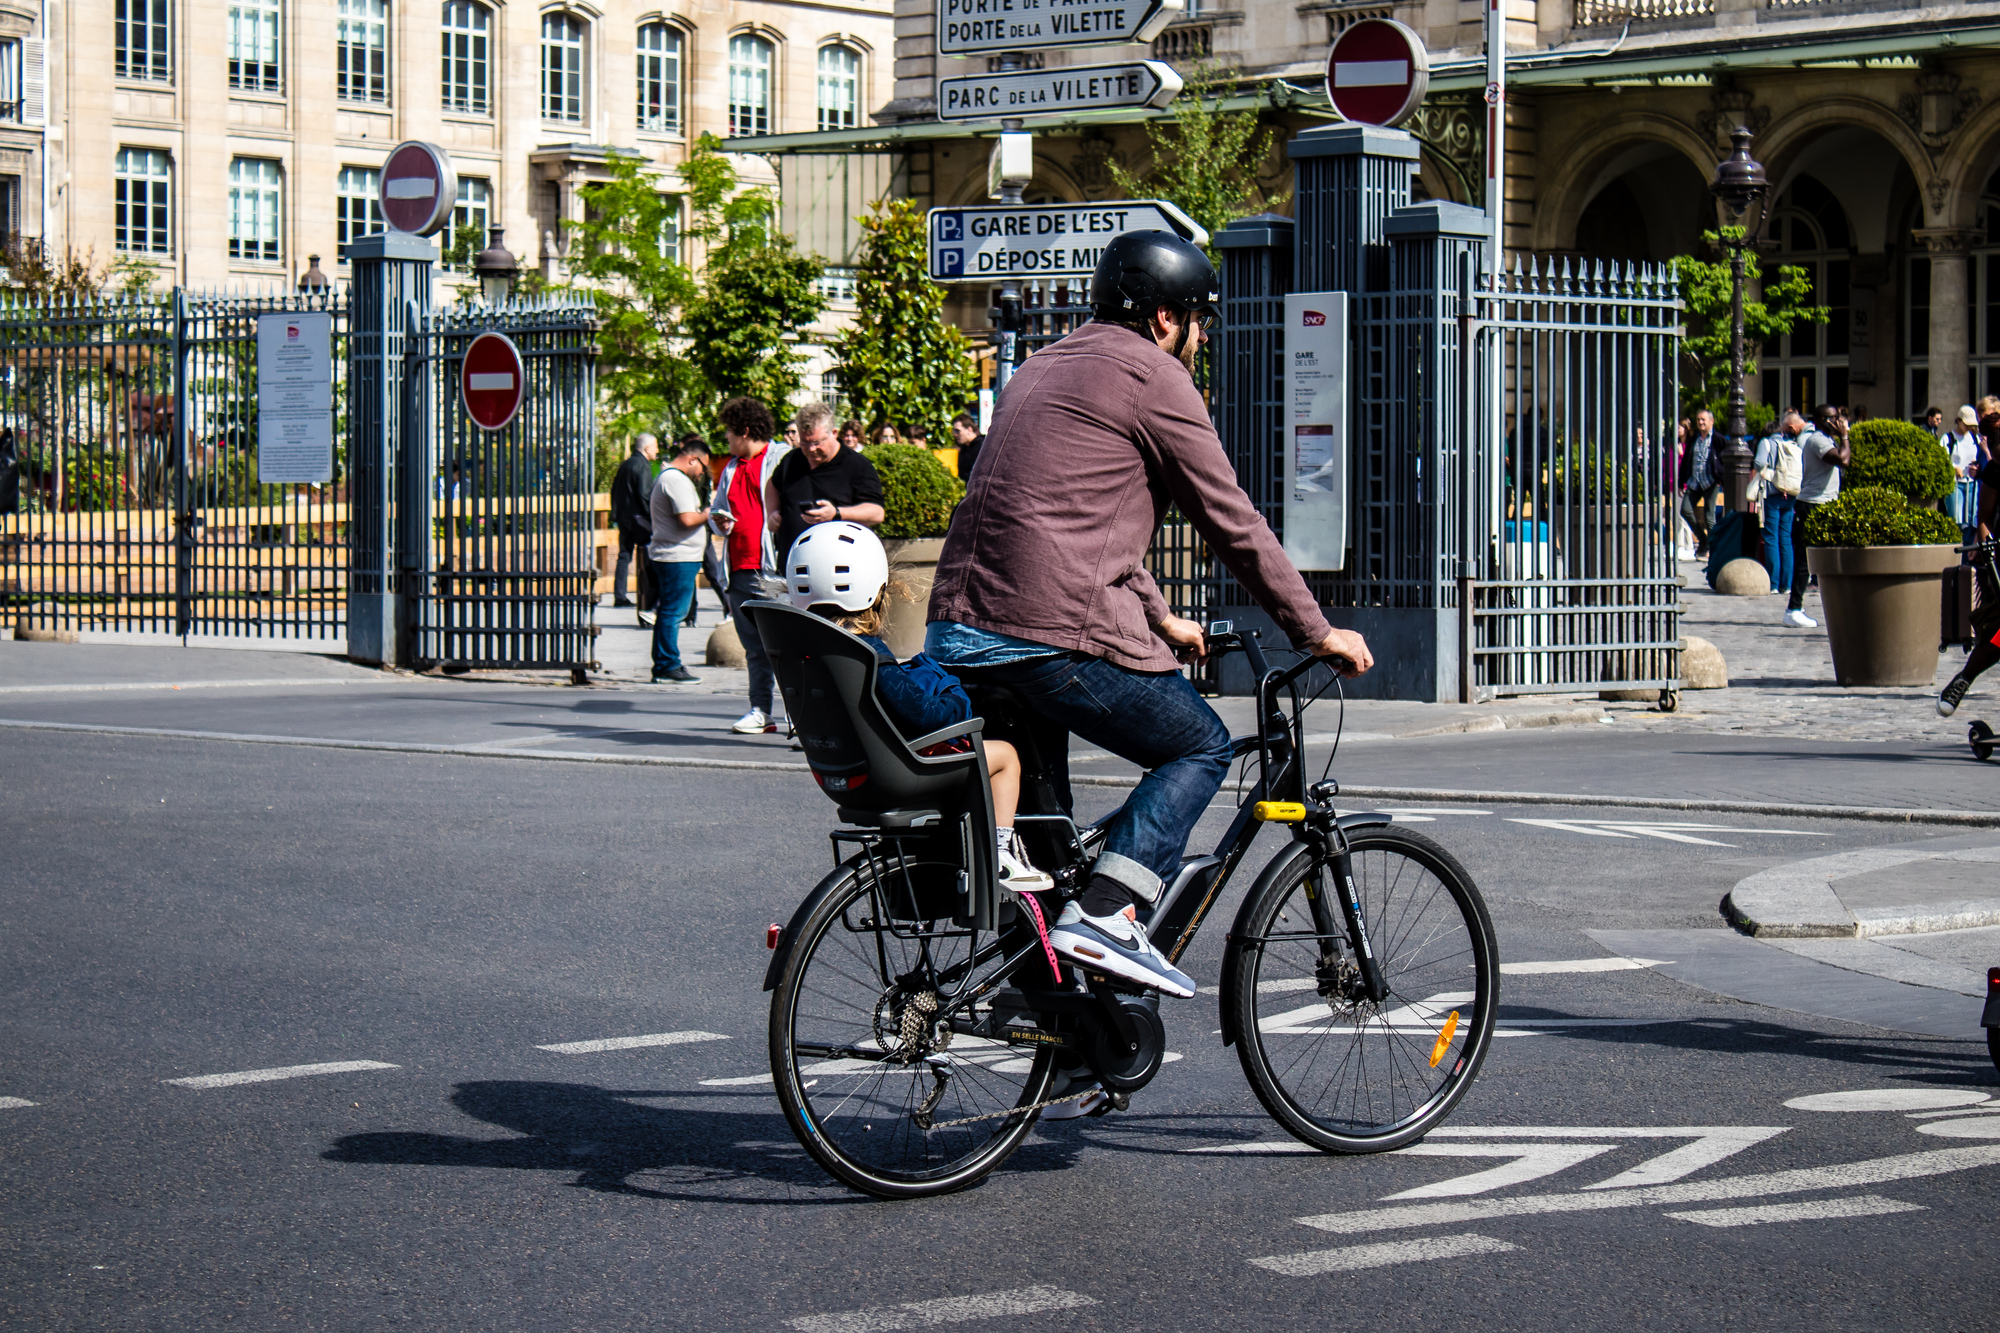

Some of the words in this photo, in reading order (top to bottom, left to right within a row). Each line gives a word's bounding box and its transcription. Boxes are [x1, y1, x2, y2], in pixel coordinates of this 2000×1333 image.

[948, 0, 1013, 15] PORTE
[948, 19, 1005, 43] PORTE
[1010, 24, 1025, 38] DE
[1027, 23, 1041, 37] LA
[1051, 9, 1126, 34] VILETTE
[948, 86, 1000, 109] PARC
[1009, 91, 1025, 104] DE
[1031, 89, 1046, 103] LA
[1052, 75, 1139, 101] VILETTE
[970, 215, 1031, 237] GARE
[1037, 214, 1066, 235] DE
[1072, 211, 1129, 233] L'EST
[943, 251, 959, 273] P
[978, 247, 1066, 272] DÉPOSE
[1072, 247, 1105, 268] MI
[1304, 316, 1325, 325] SNCF
[1295, 351, 1314, 359] GARE
[1168, 935, 1187, 964] USTACHE
[1021, 1032, 1039, 1040] SELLE
[1040, 1035, 1064, 1044] MARCEL
